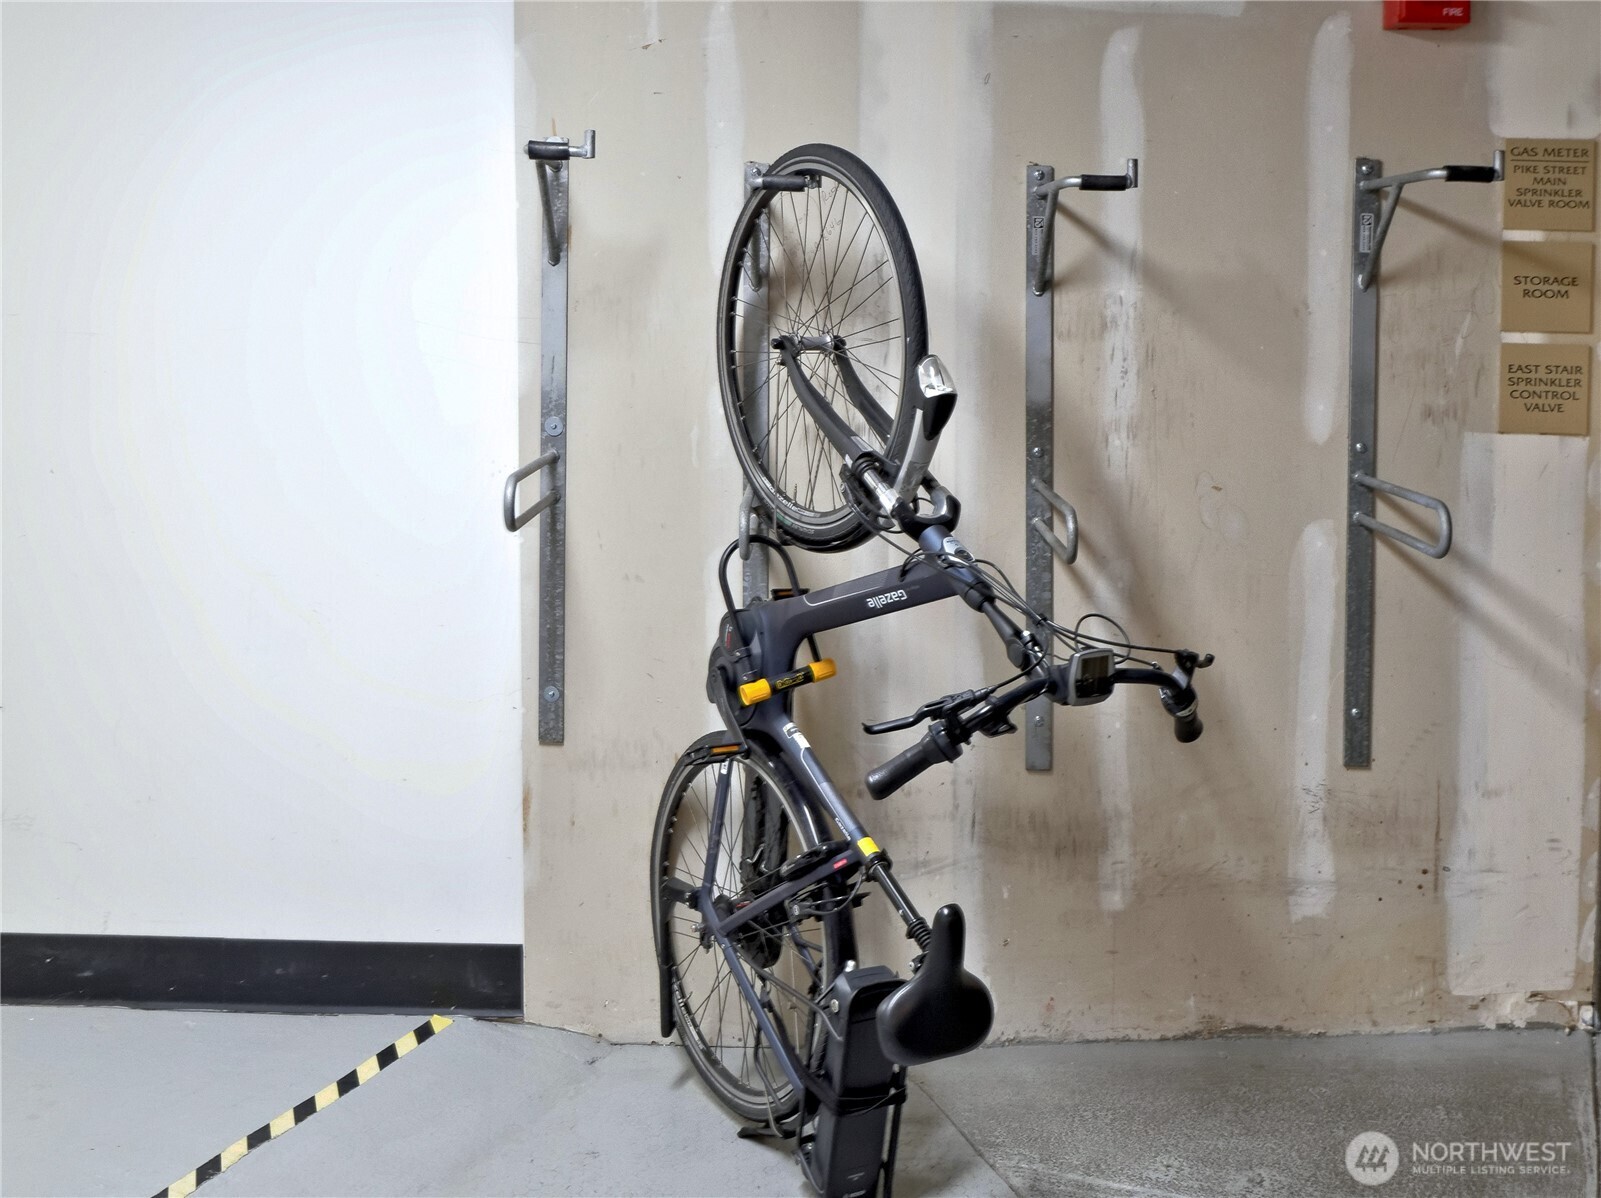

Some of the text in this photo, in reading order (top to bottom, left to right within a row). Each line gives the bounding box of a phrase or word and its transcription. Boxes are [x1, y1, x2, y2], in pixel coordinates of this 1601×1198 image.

[1442, 7, 1464, 17] FIRE
[1510, 146, 1590, 158] GAS METER
[1513, 164, 1587, 175] PIKE STREET
[1532, 177, 1567, 186] MAIN
[1516, 187, 1583, 198] SPRINKLER
[1508, 199, 1590, 209] VALVE ROOM
[1513, 275, 1580, 287] STORAGE
[1522, 288, 1570, 299] ROOM
[1507, 364, 1583, 375] EAST STAIR
[1507, 377, 1582, 388] SPRINKLER
[1509, 390, 1580, 401] CONTROL
[1524, 402, 1565, 413] VALVE
[866, 589, 908, 609] Gazelle
